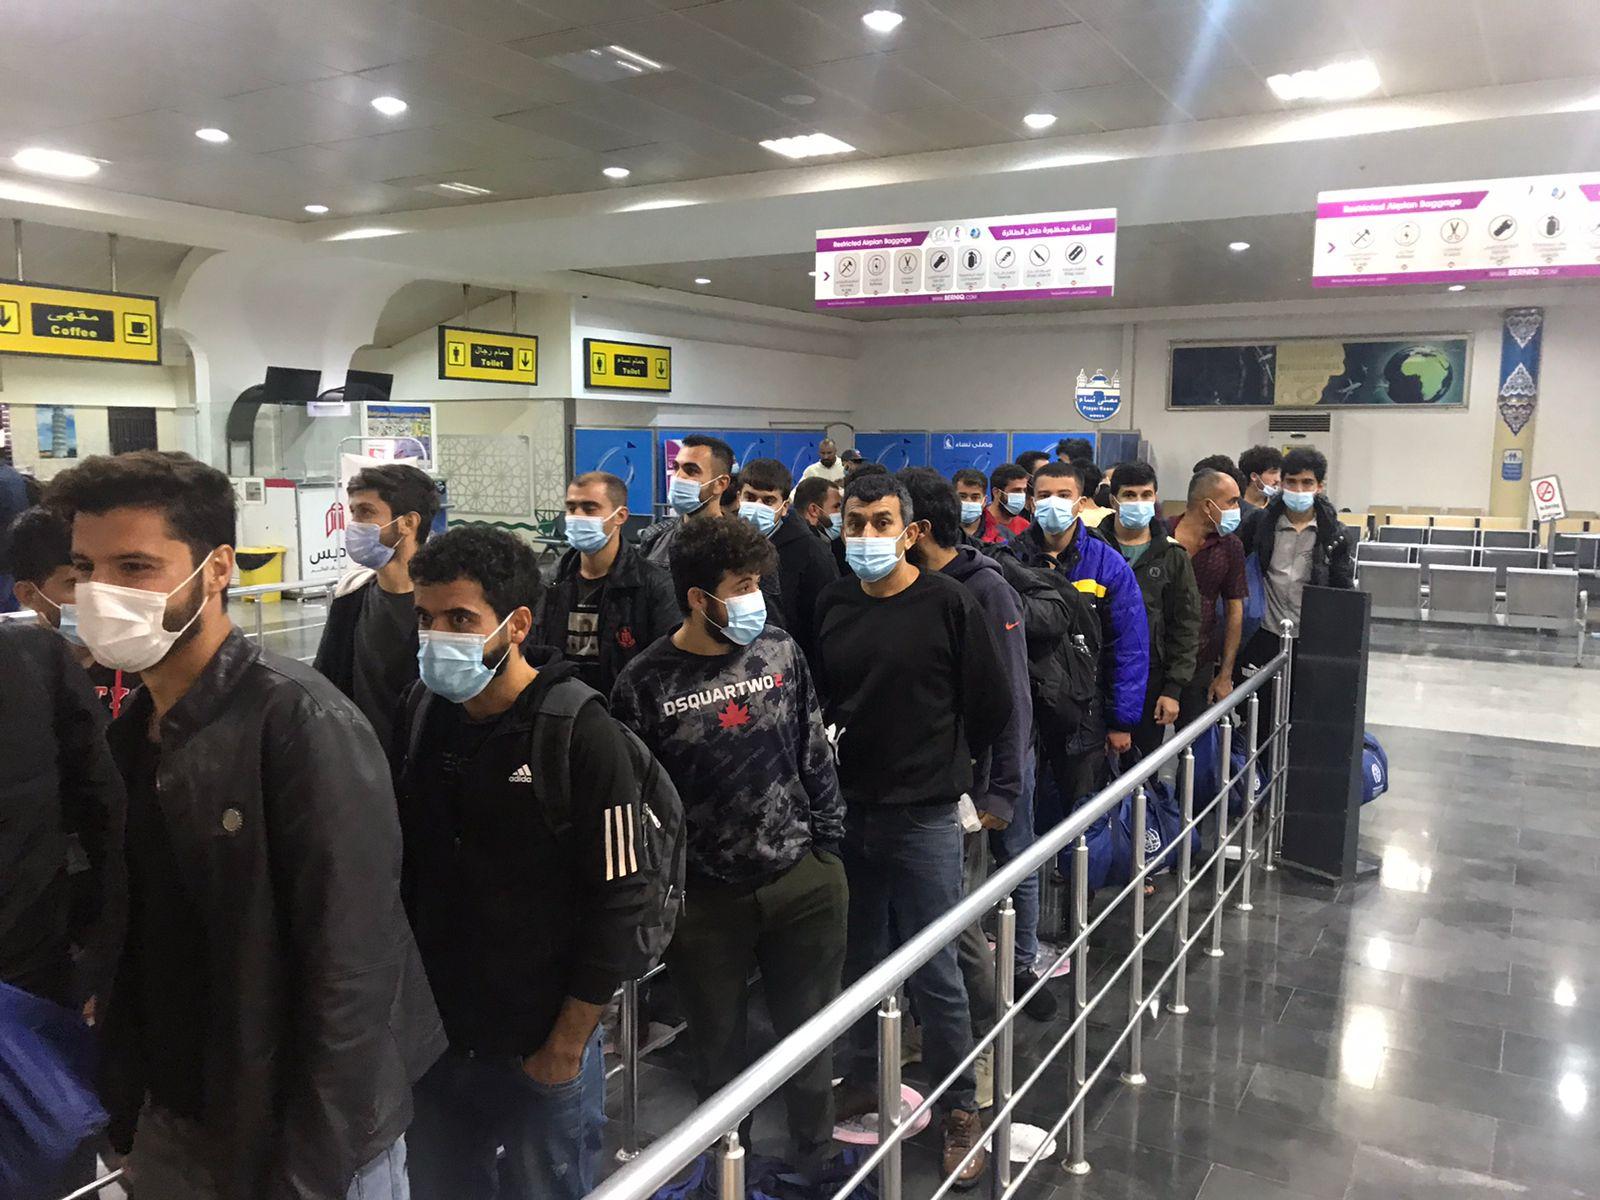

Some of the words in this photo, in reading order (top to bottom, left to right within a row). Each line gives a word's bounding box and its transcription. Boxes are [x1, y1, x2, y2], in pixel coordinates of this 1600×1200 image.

[833, 239, 861, 248] Restricted
[884, 237, 912, 245] Baggage
[47, 310, 99, 321] مقهى
[50, 324, 98, 338] Coffee
[475, 346, 492, 356] رجال
[494, 349, 510, 357] حمام
[481, 358, 504, 368] Toilet
[622, 367, 641, 375] Toilet
[971, 441, 993, 449] مصلى
[508, 775, 532, 783] adida
